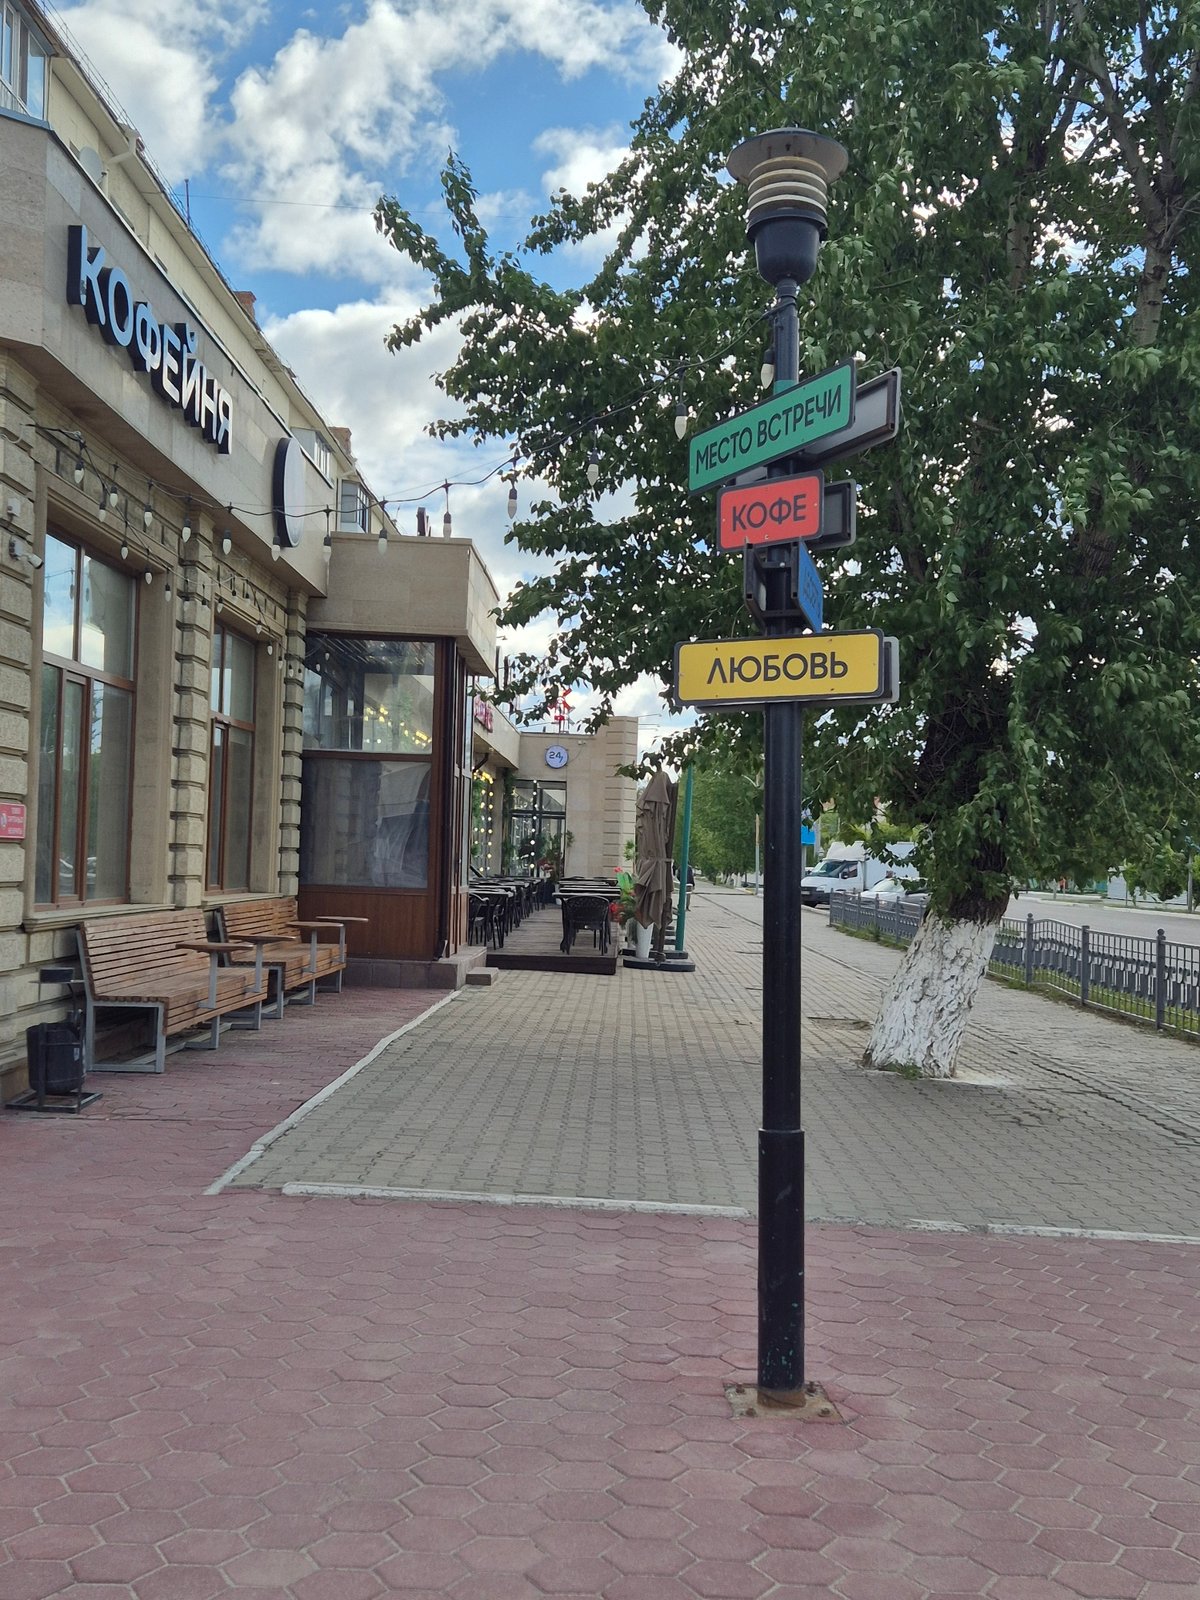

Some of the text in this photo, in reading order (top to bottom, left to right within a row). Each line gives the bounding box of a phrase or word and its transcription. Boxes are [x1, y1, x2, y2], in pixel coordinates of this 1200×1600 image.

[68, 224, 233, 455] КОФЕЙНЯ
[695, 384, 842, 474] МЕСТО ВСТРЕЧИ
[732, 494, 807, 532] КОФЕ
[706, 651, 849, 685] ЛЮБОВЬ
